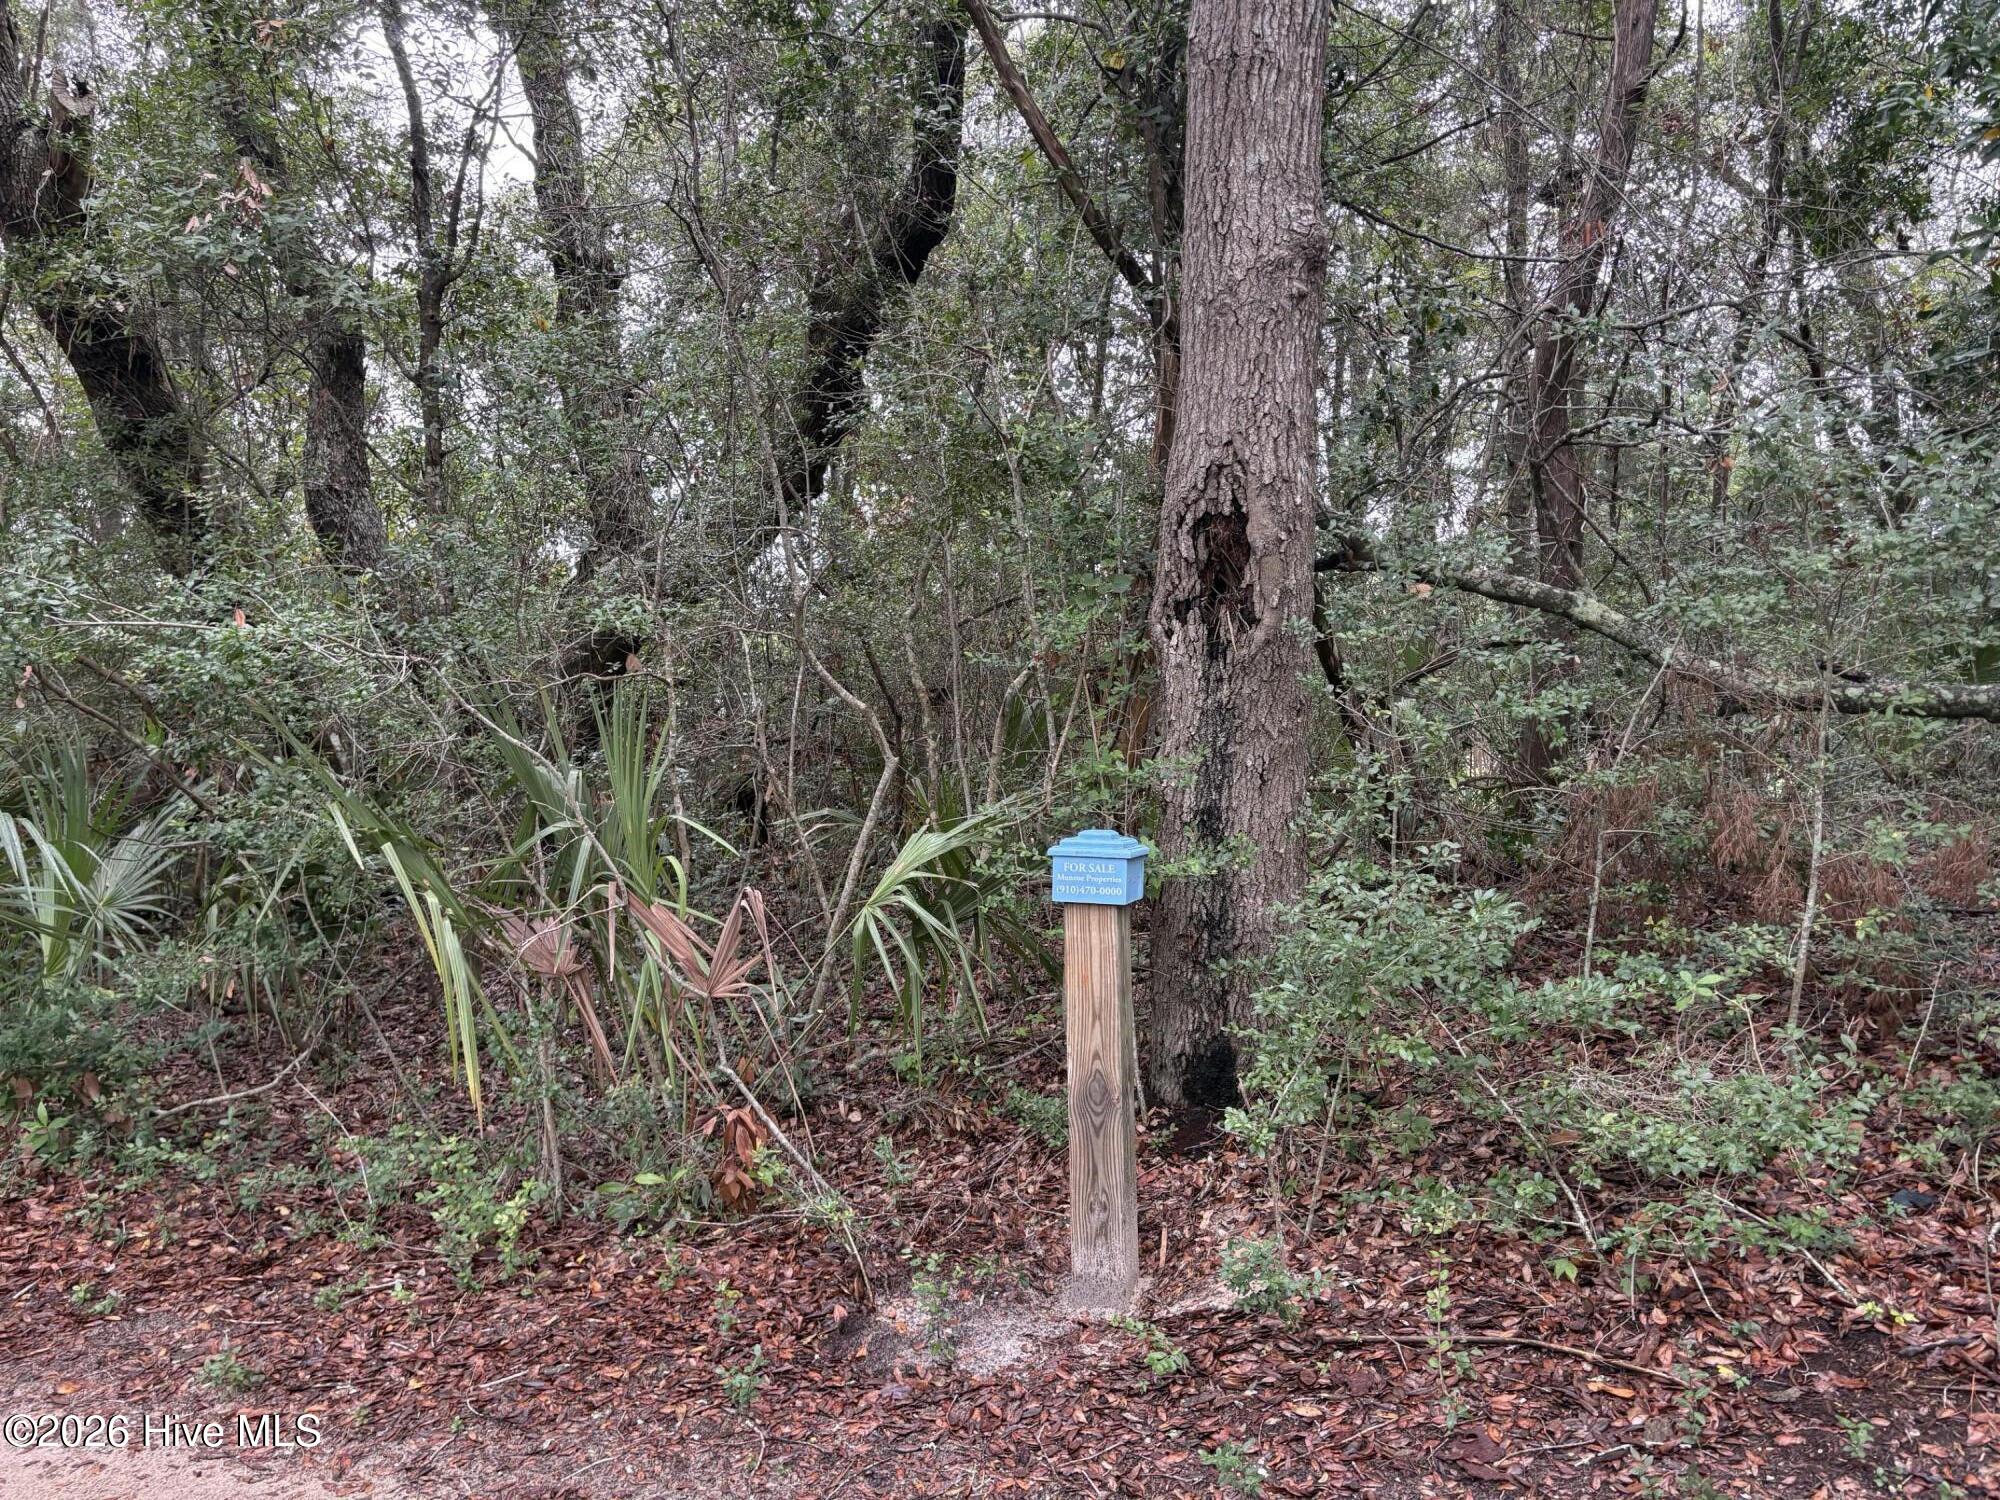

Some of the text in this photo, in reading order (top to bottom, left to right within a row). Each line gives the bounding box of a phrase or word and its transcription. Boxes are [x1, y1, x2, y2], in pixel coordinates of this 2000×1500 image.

[1064, 862, 1116, 874] FOR SALE
[1086, 874, 1122, 884] Properties
